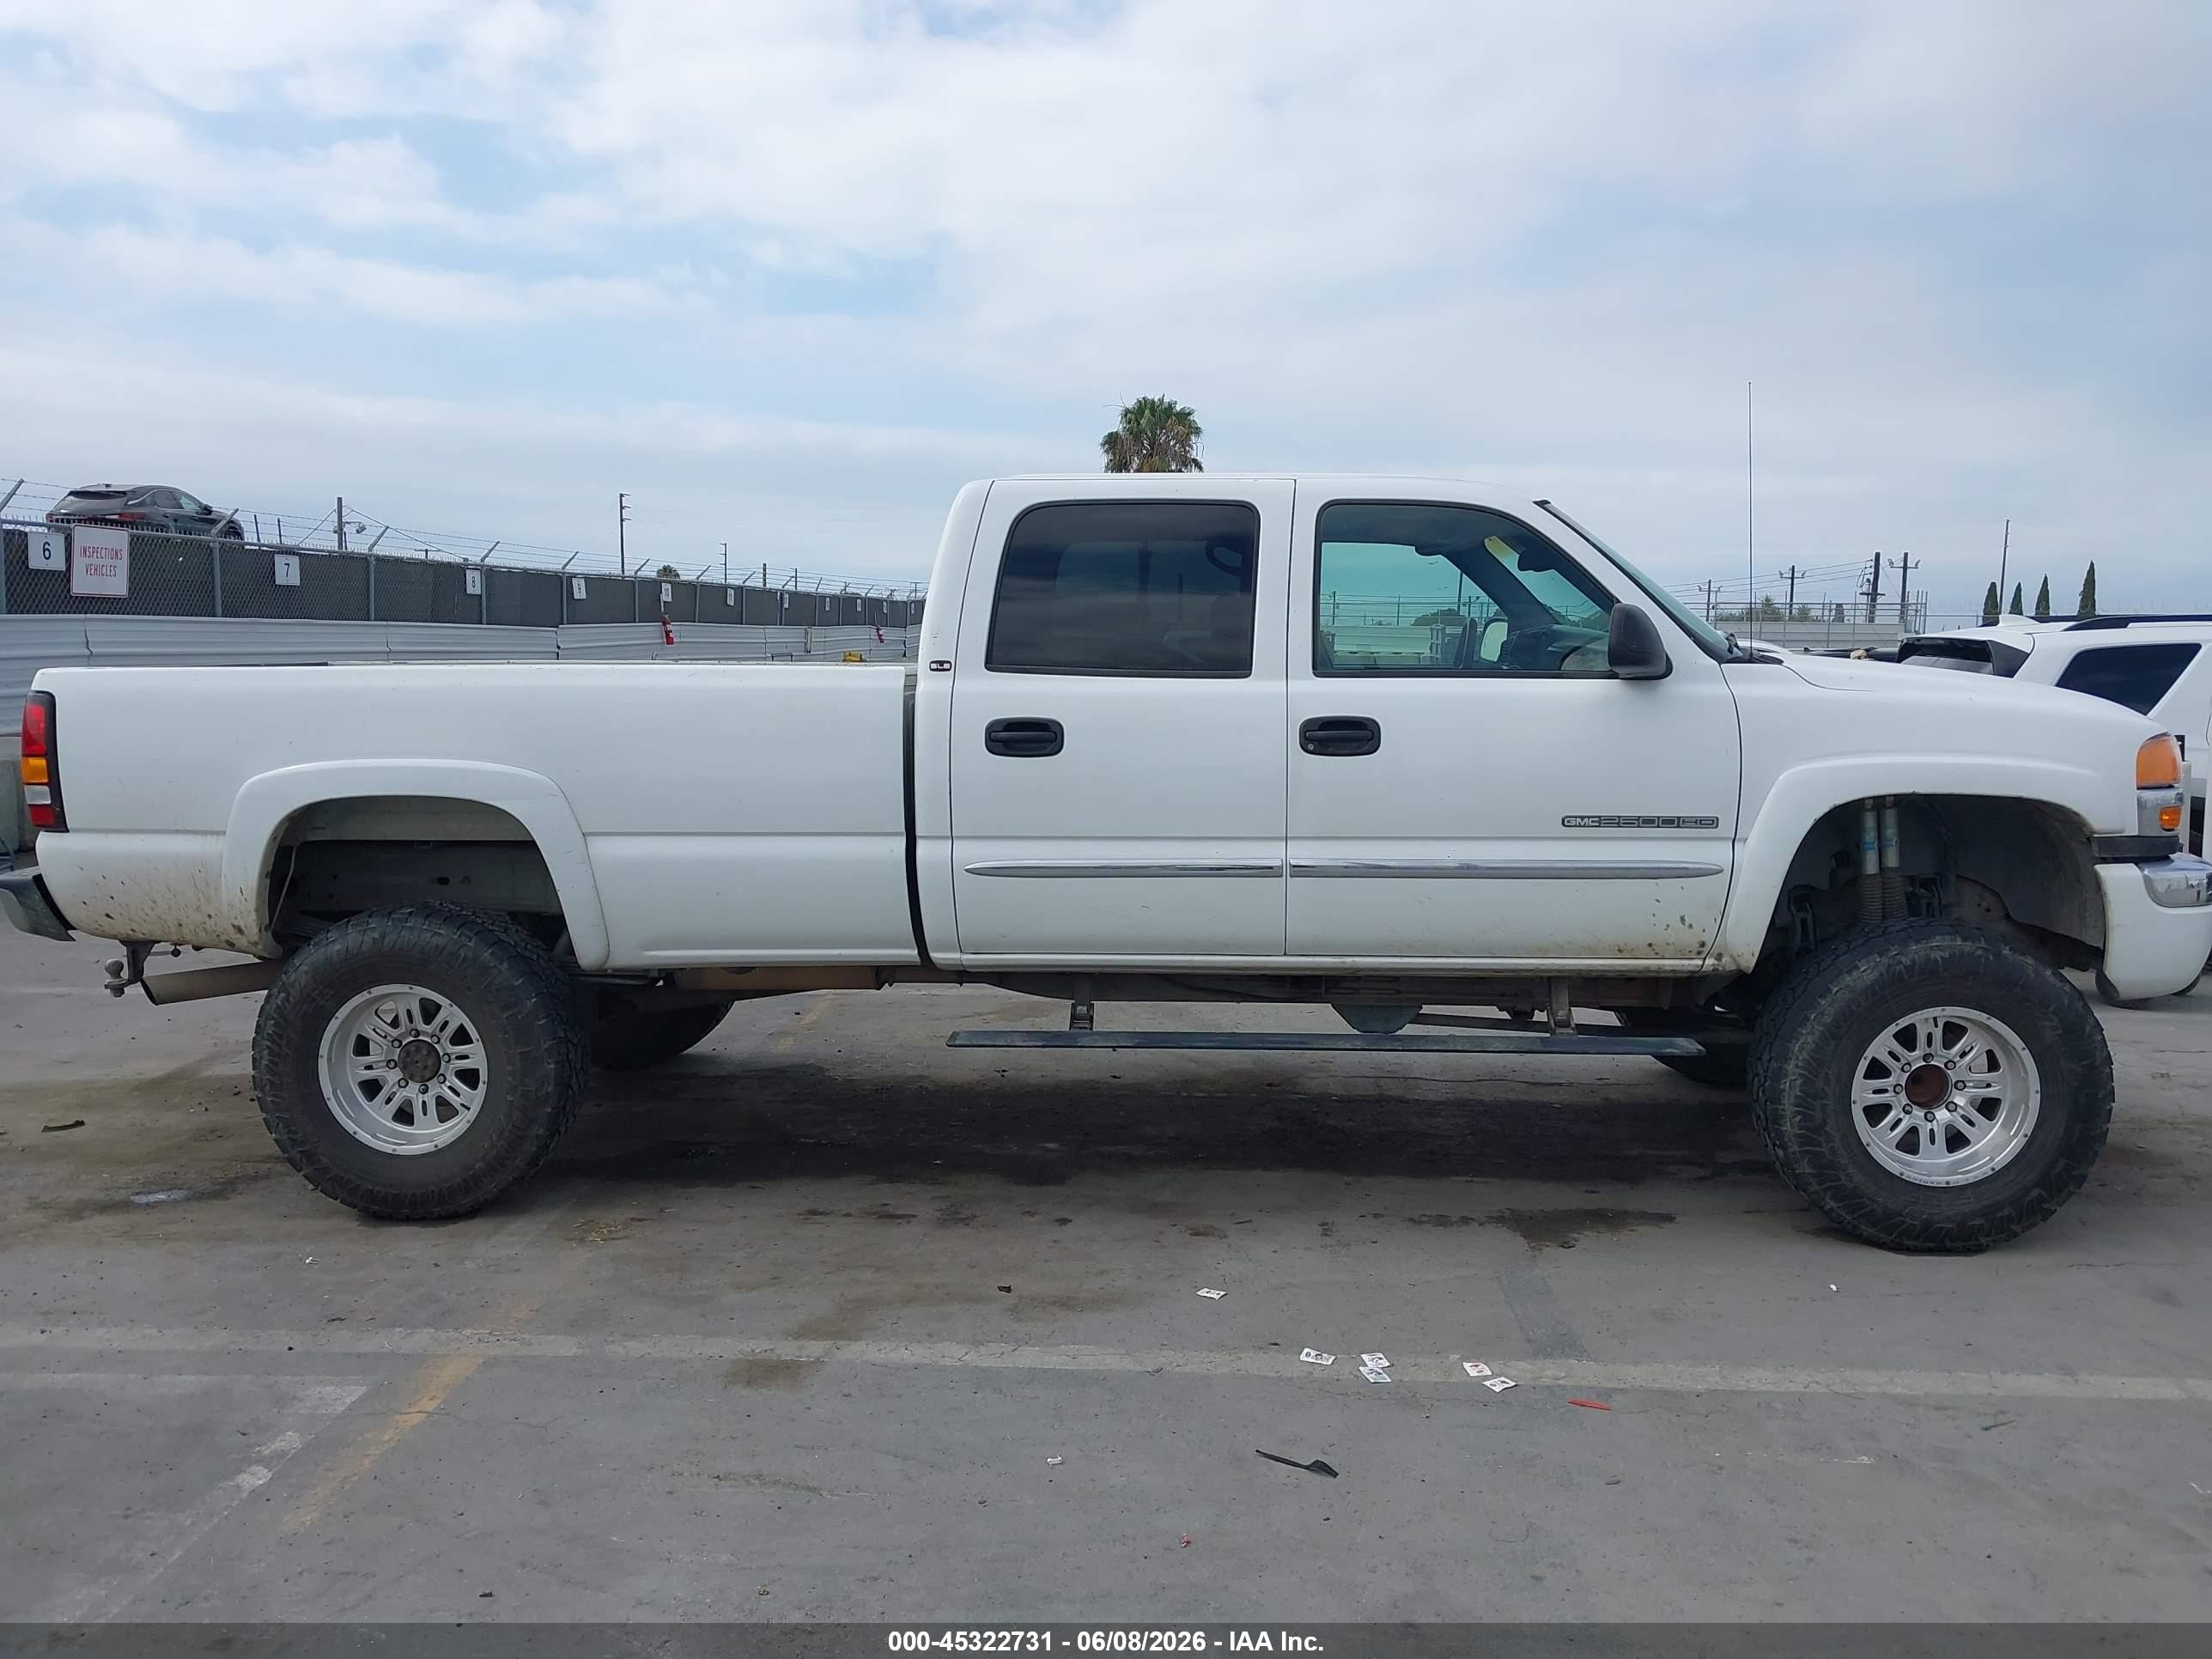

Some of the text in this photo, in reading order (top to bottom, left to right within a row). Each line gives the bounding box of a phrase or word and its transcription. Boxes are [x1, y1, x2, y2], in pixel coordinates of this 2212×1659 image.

[42, 541, 52, 560] 6
[80, 544, 123, 561] INSPECTIONS
[85, 562, 117, 577] VEHICLES
[283, 563, 290, 577] 7
[471, 575, 476, 588] 8
[1564, 817, 1600, 826] GMC
